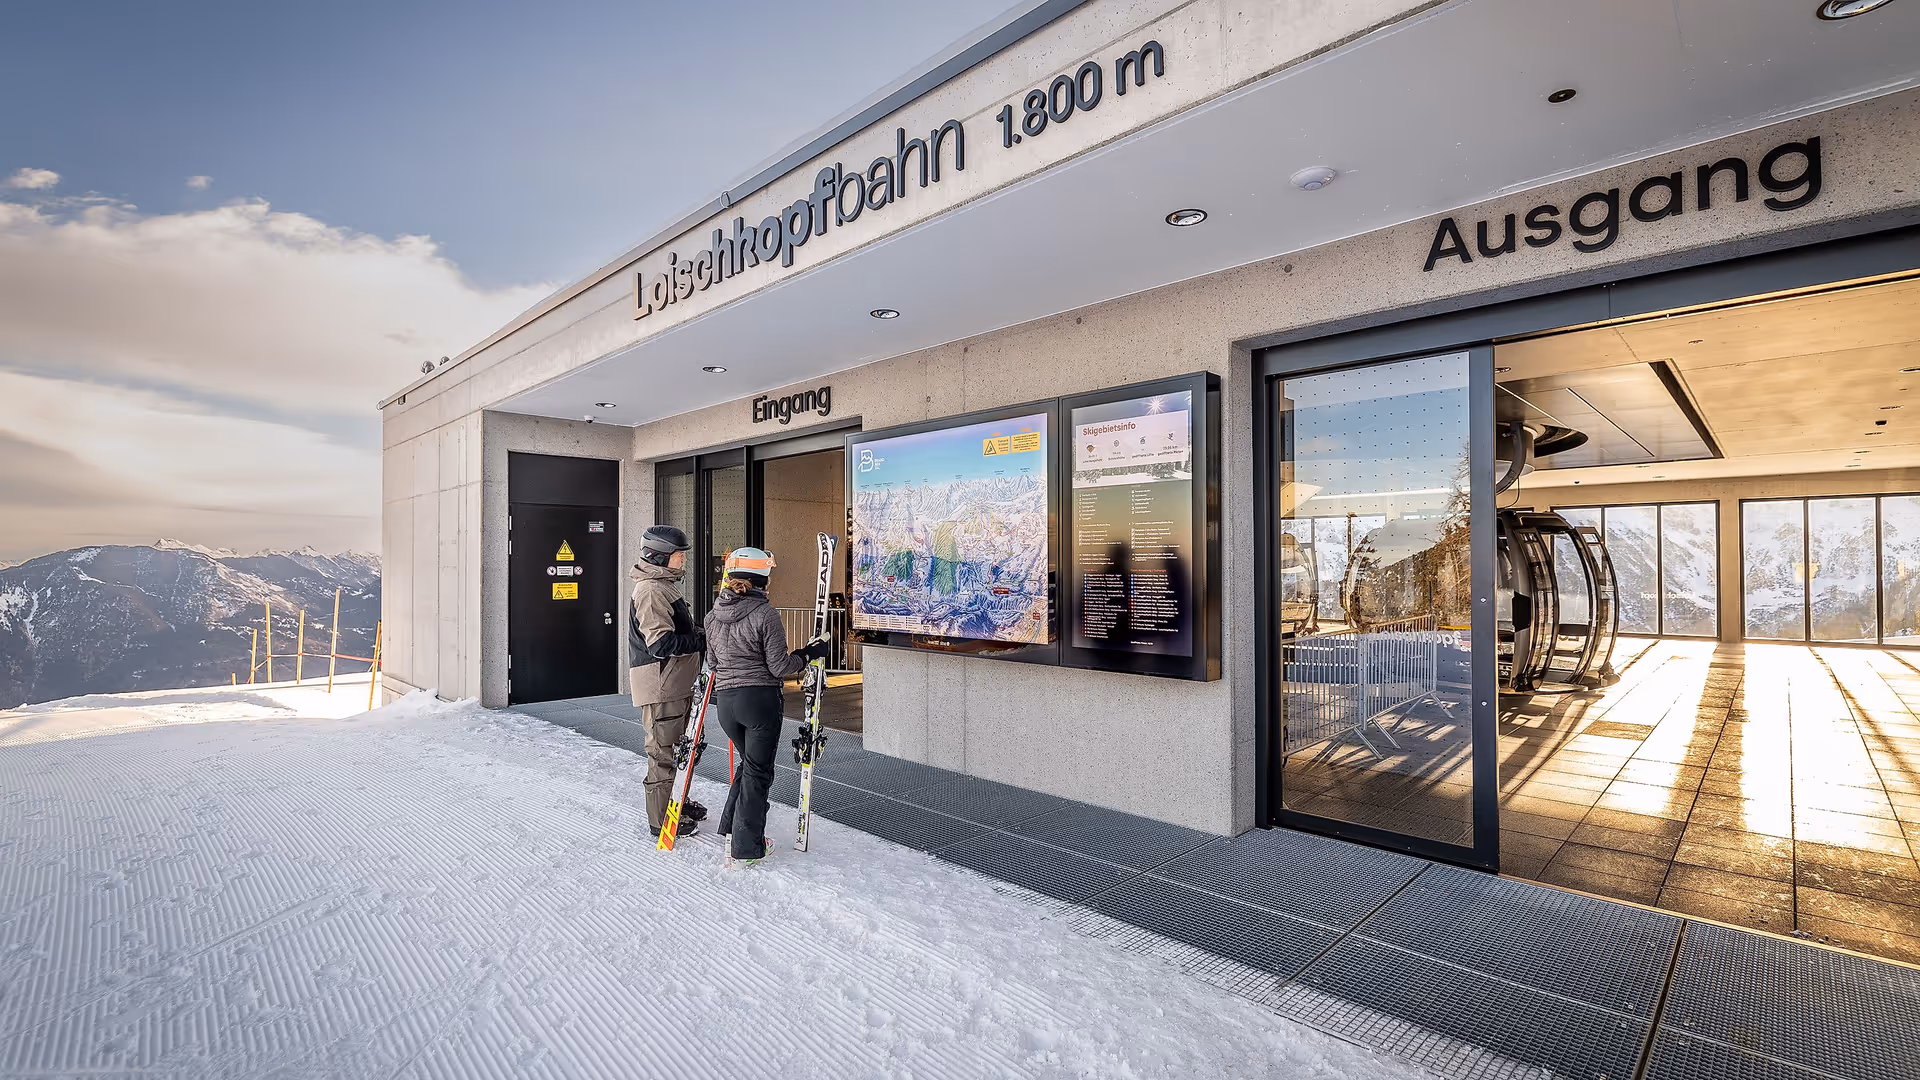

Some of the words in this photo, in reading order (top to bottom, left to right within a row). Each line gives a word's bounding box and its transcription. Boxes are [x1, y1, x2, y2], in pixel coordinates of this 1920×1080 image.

[632, 118, 965, 321] Loischkopfbahn
[995, 61, 1103, 149] 1.800
[1114, 39, 1165, 96] m
[1422, 135, 1822, 272] Ausgang
[752, 385, 832, 426] Eingang
[1082, 421, 1137, 437] Skigebietsinfo
[816, 551, 829, 617] HEAD
